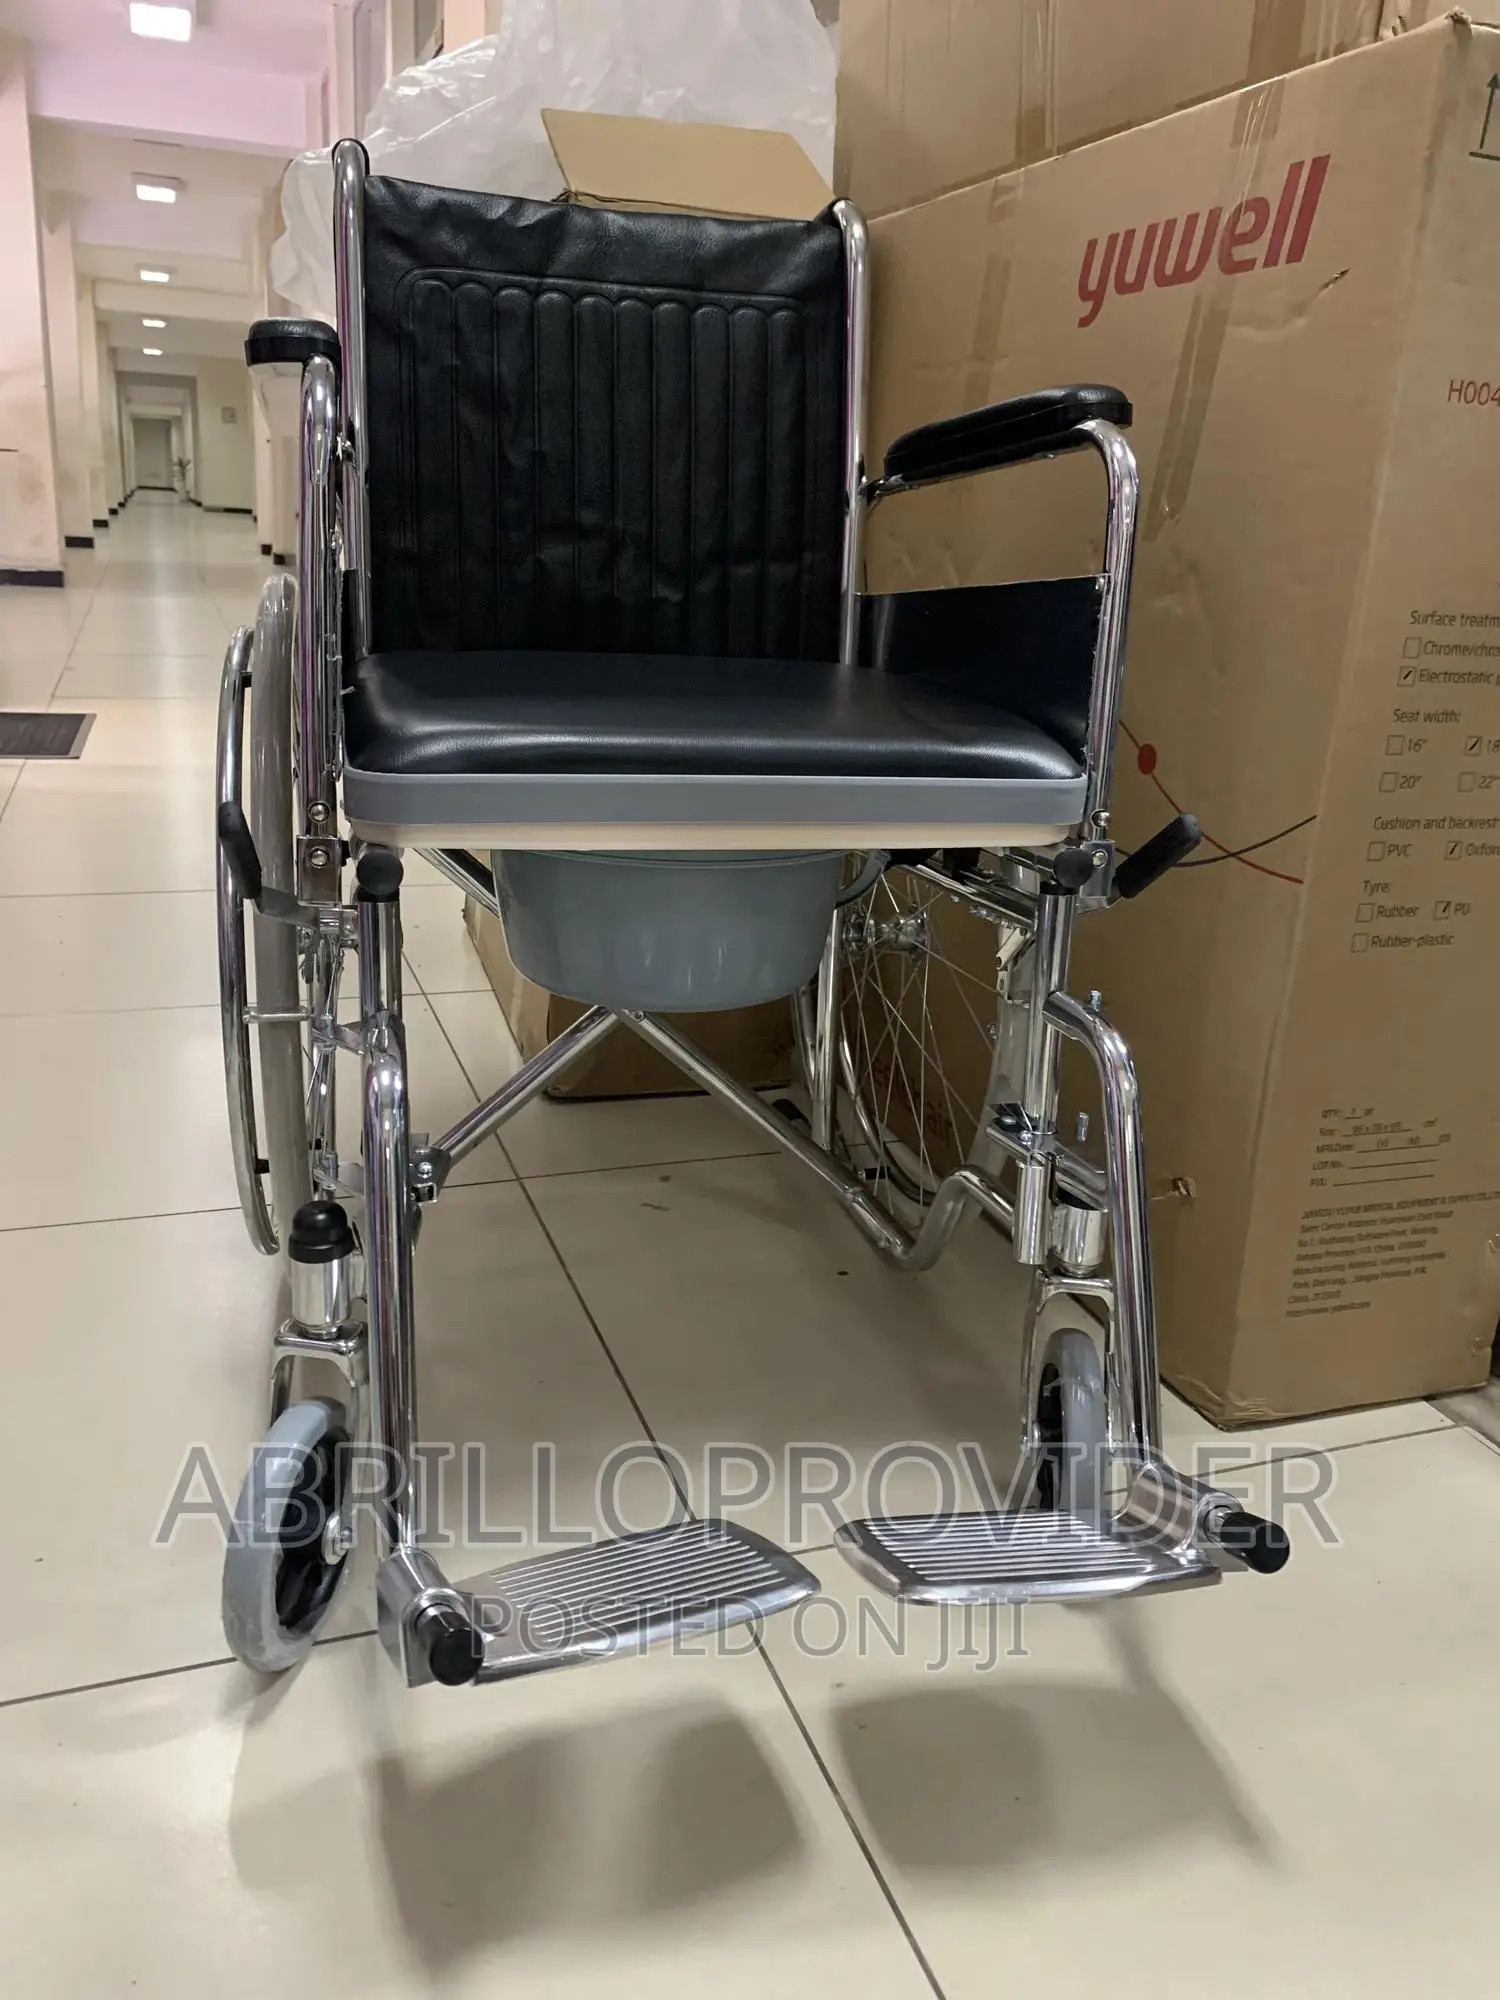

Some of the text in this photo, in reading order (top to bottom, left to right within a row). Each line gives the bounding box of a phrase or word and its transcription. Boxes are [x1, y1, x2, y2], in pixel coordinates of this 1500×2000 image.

[1077, 153, 1331, 329] yuwell
[1410, 609, 1456, 627] Surface
[1419, 668, 1493, 685] Electrostatic
[1393, 708, 1461, 724] Seat width:
[1374, 816, 1420, 831] Cushion
[1423, 816, 1446, 830] and
[1387, 843, 1412, 857] PVC
[1376, 902, 1471, 919] Rubber PU
[1371, 934, 1455, 948] Rubber-plastic
